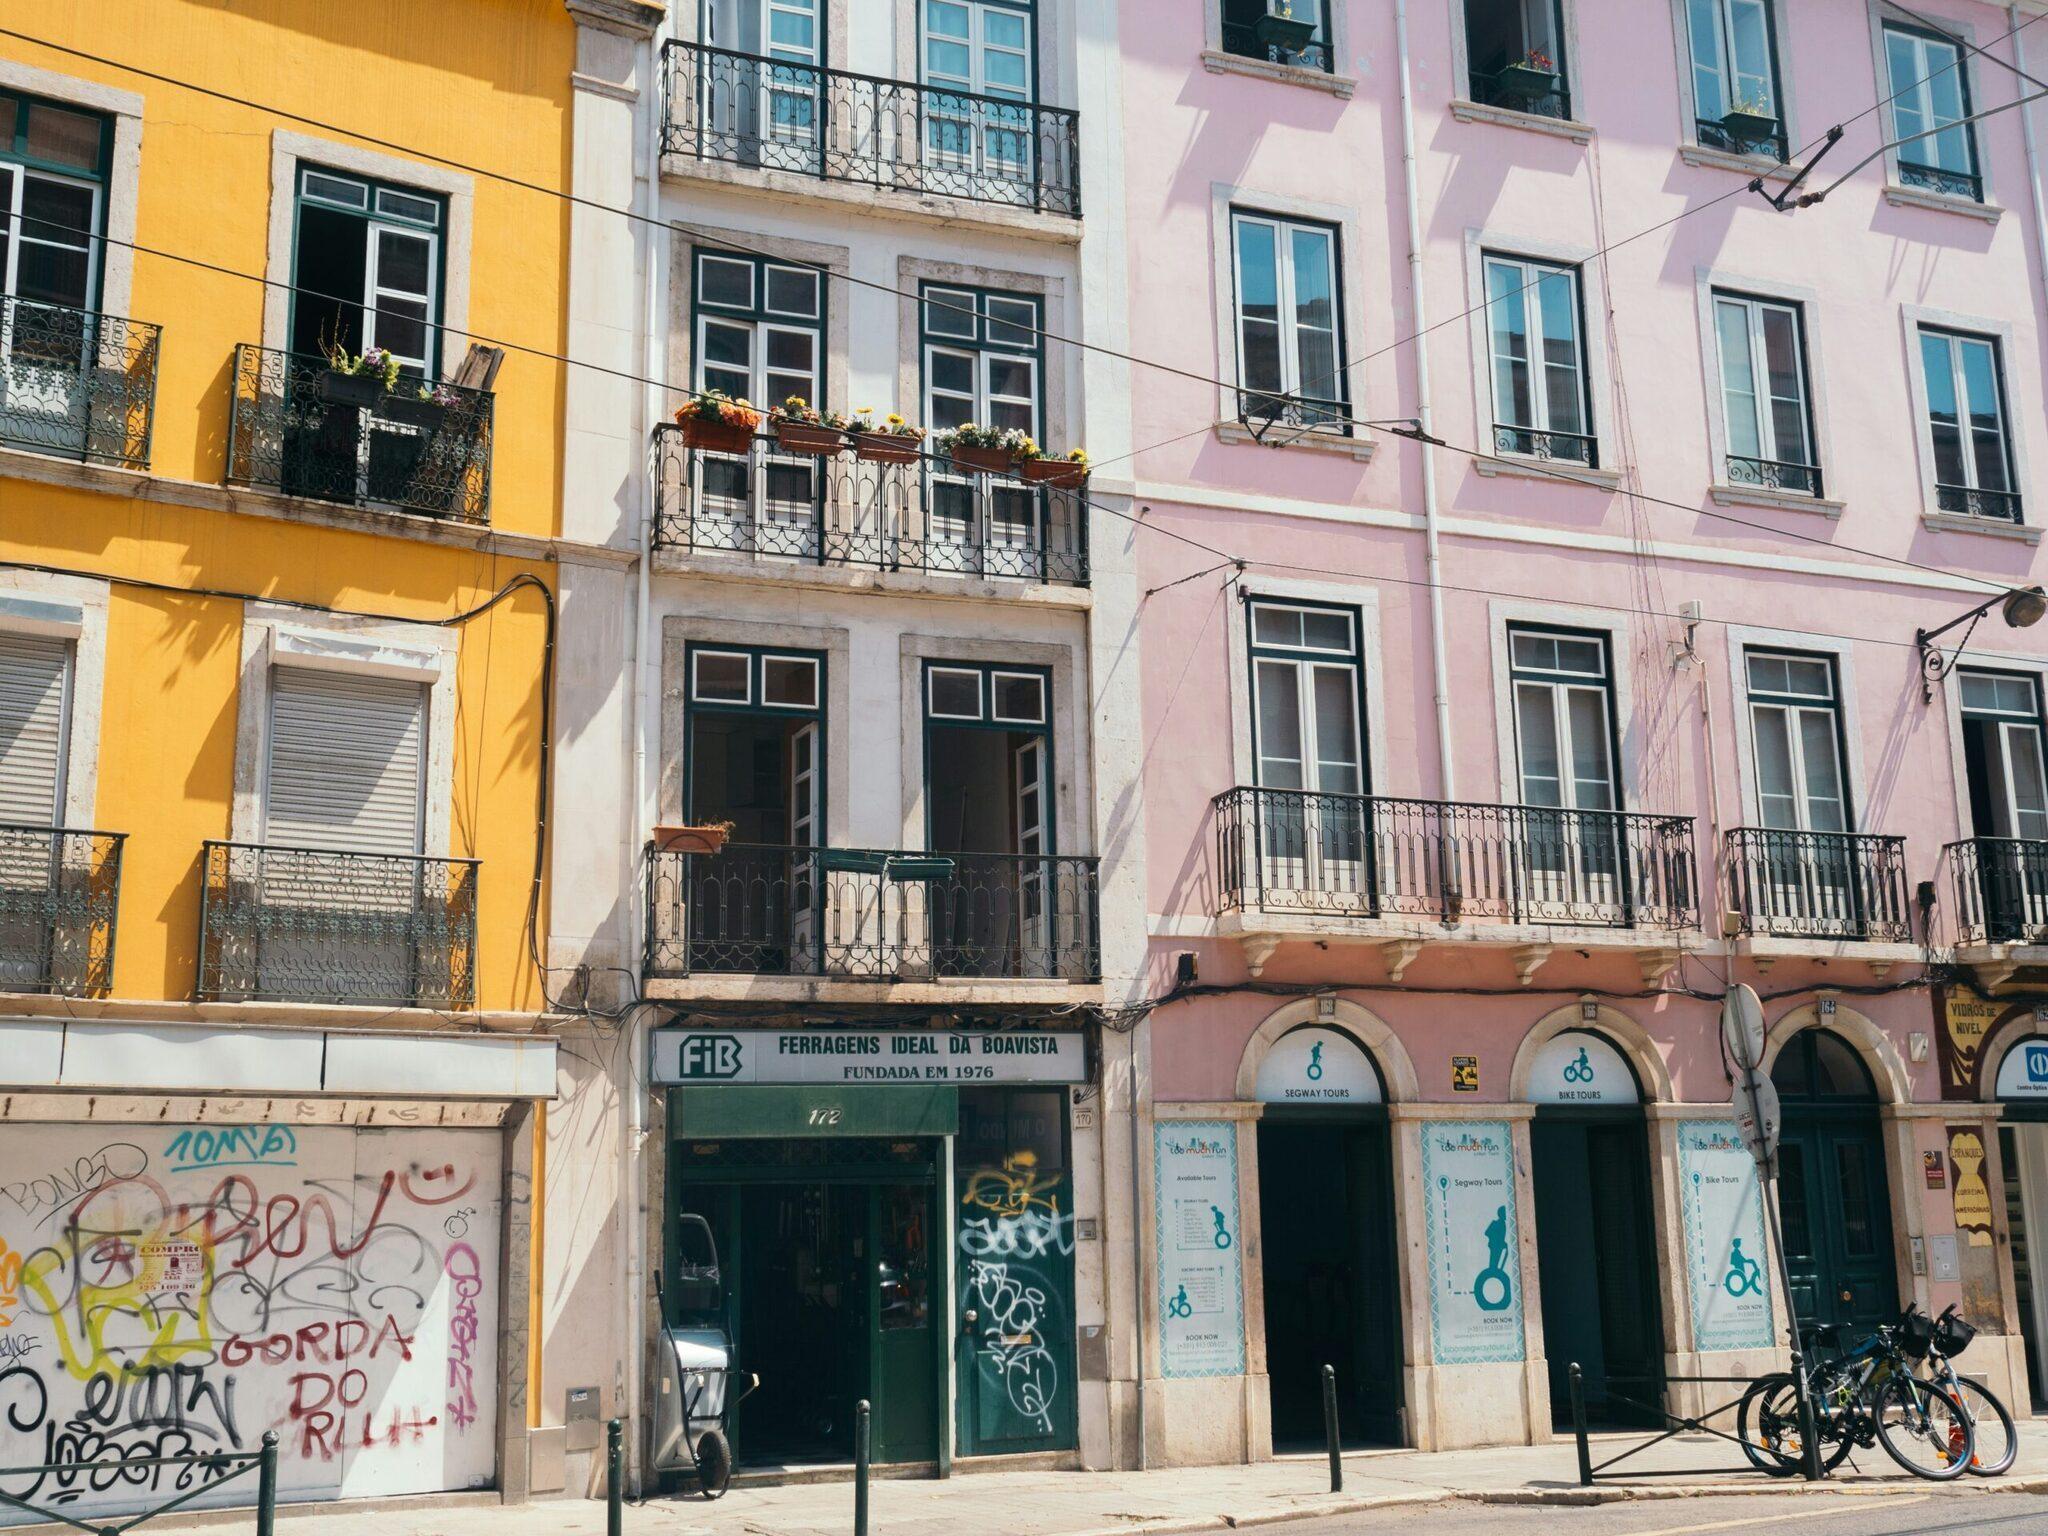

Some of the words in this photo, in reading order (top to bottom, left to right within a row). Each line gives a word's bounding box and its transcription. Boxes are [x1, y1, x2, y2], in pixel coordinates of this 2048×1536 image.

[1320, 999, 1333, 1014] 168
[1584, 1006, 1596, 1018] 166
[1951, 1003, 1984, 1017] VIDROS
[1986, 1007, 1997, 1017] DE
[1956, 1022, 1982, 1034] NIVEL
[779, 1036, 880, 1055] FERRAGENS
[891, 1036, 938, 1055] IDEAL
[950, 1036, 970, 1055] DA
[982, 1036, 1058, 1055] BOAVISTA
[843, 1066, 920, 1079] FUNDADA
[925, 1066, 948, 1079] EM
[955, 1066, 994, 1079] 1976
[1285, 1089, 1320, 1098] SEGWAY
[1324, 1089, 1350, 1098] TOURS
[1559, 1091, 1575, 1099] BIKE
[1577, 1091, 1601, 1099] TOURS
[809, 1109, 841, 1125] 172
[1076, 1113, 1091, 1126] 170
[1458, 1142, 1483, 1152] much
[1455, 1179, 1482, 1188] Segway
[1485, 1178, 1503, 1186] Tours
[1706, 1176, 1720, 1184] Bike
[1722, 1175, 1739, 1183] Tours
[221, 1313, 415, 1367] GORDA
[287, 1369, 368, 1419] DO
